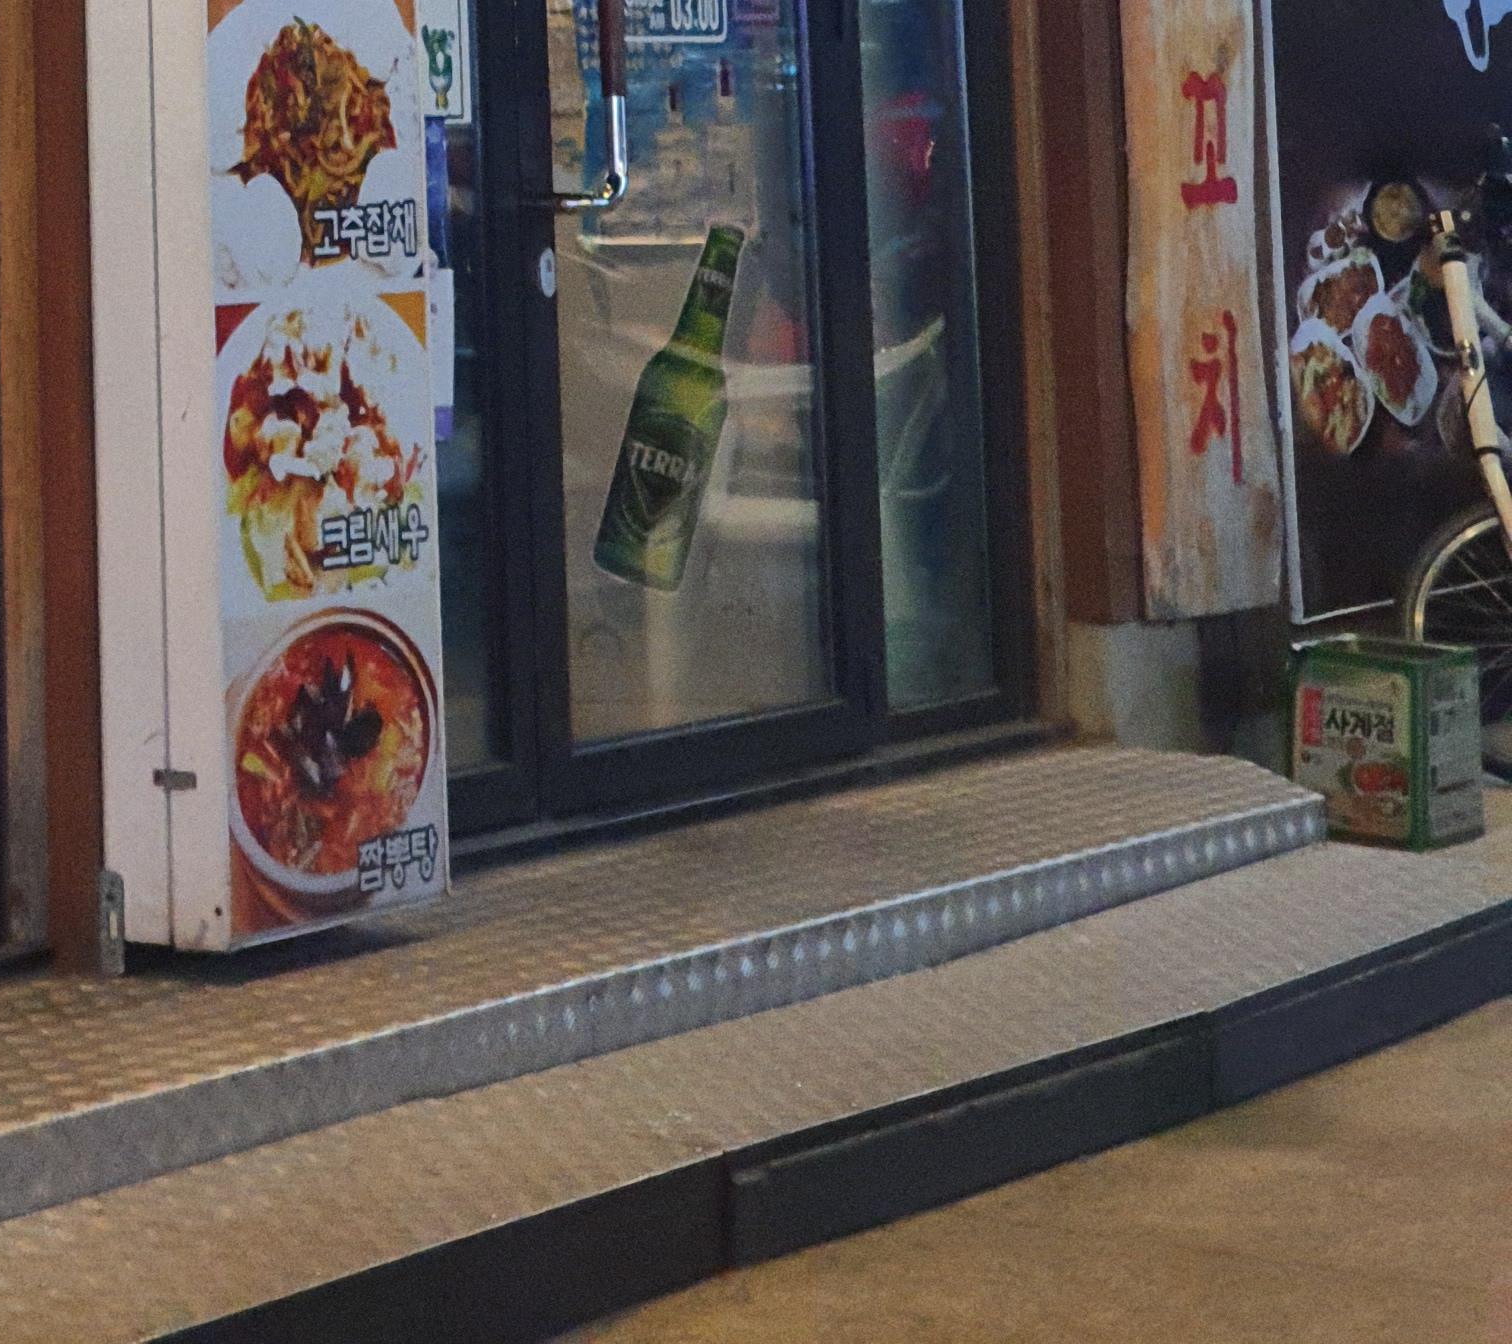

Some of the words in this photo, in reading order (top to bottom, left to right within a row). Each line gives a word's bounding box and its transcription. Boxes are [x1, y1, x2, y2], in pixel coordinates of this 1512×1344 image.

[313, 199, 417, 257] 고추잡채
[321, 506, 429, 568] 크림새우
[358, 825, 439, 893] 짬뽕탕
